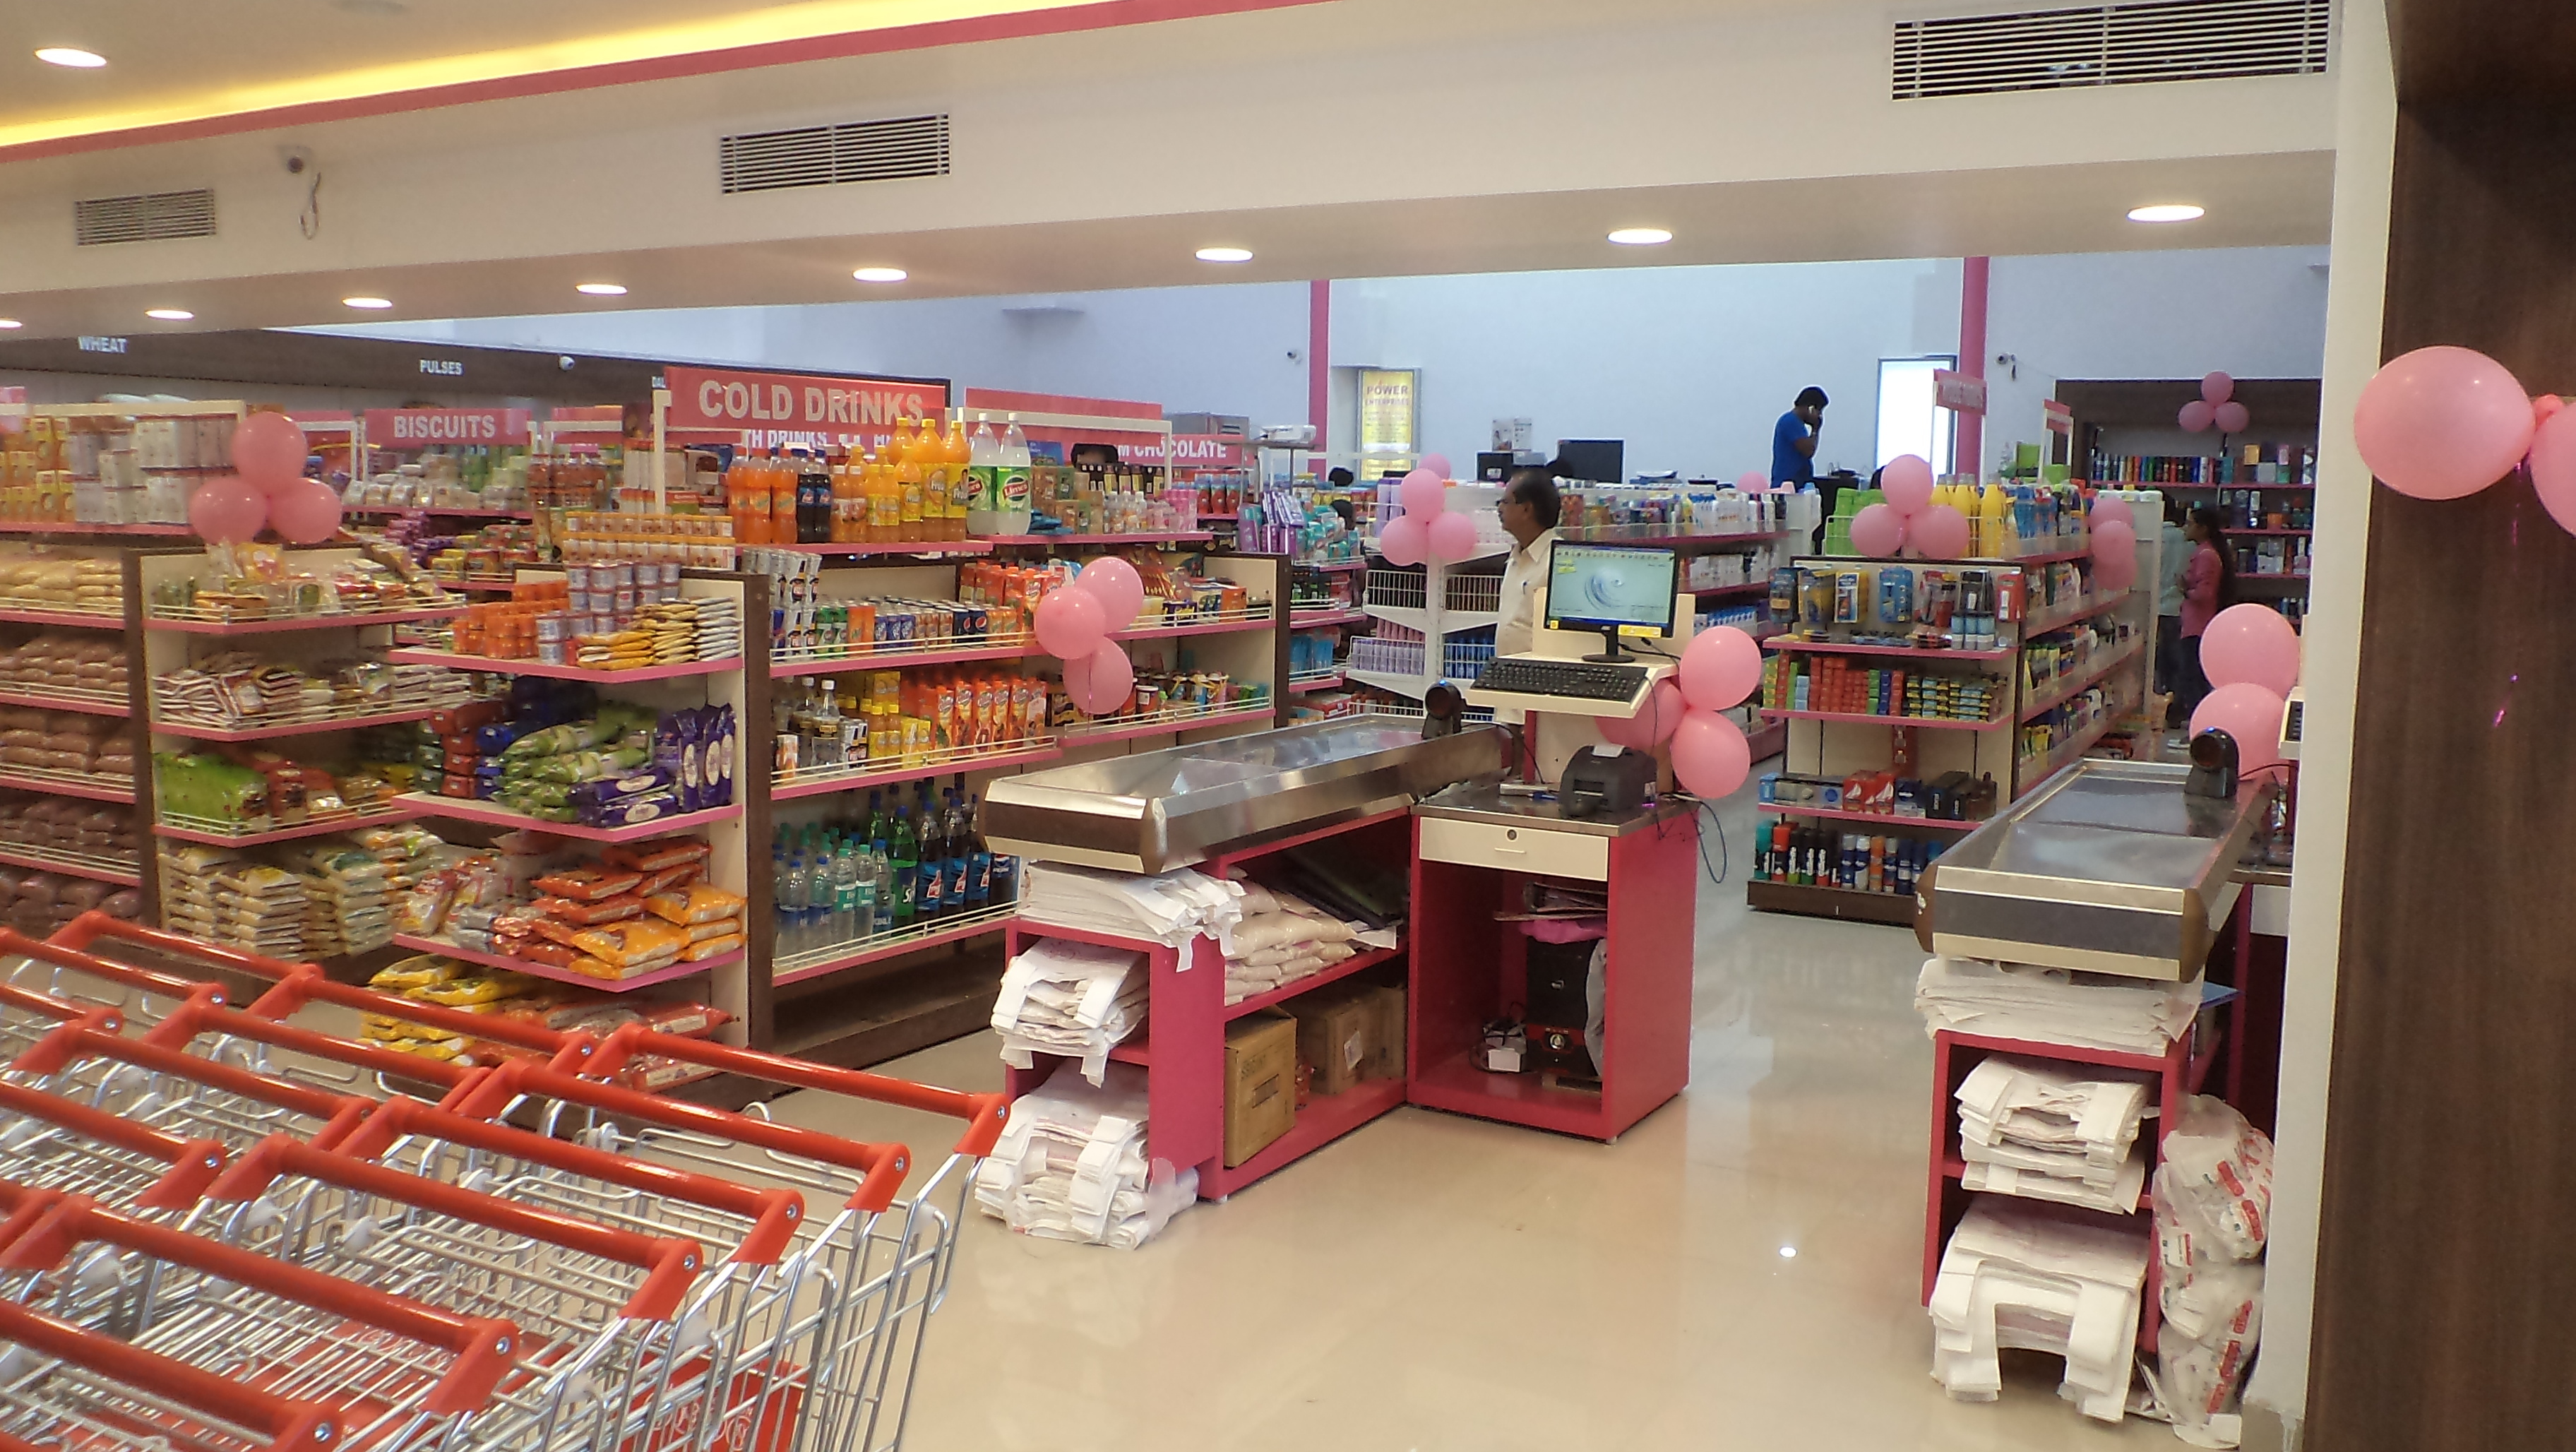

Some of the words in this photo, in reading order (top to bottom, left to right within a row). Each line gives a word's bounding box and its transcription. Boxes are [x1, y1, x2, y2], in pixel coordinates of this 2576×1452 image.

[78, 336, 127, 354] WHEAT
[419, 359, 463, 375] PULSES
[1366, 385, 1409, 395] POWER
[699, 380, 794, 421] COLD
[804, 386, 924, 427] DRINKS
[393, 415, 496, 439] BISCUITS
